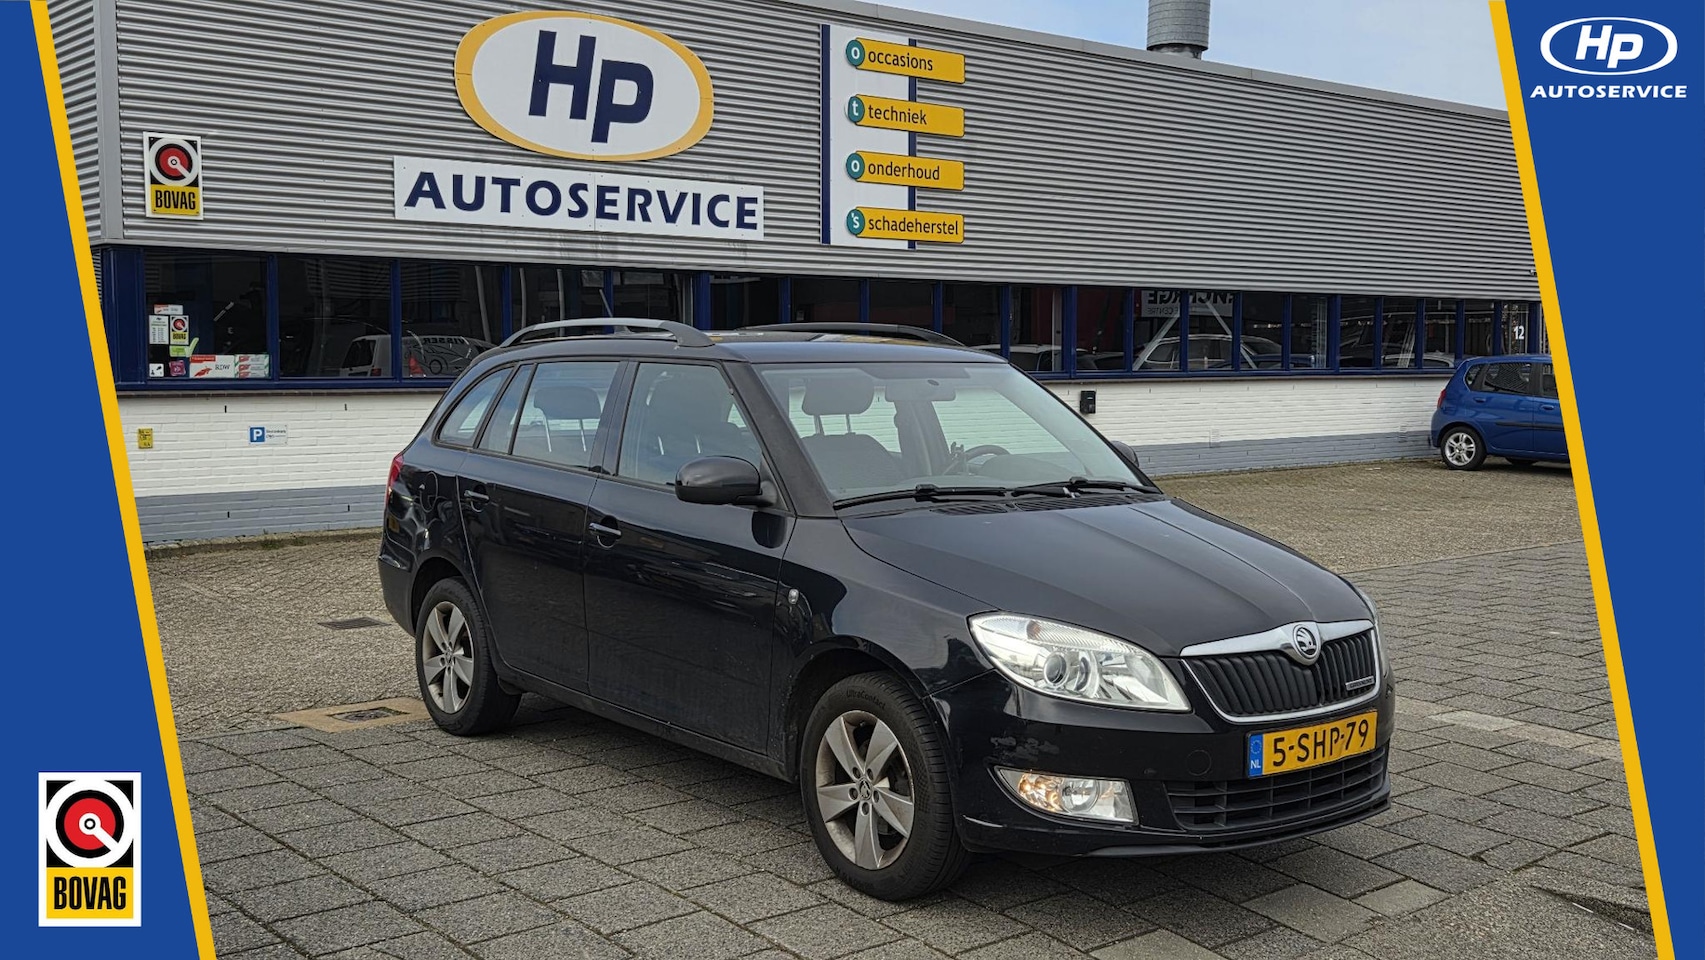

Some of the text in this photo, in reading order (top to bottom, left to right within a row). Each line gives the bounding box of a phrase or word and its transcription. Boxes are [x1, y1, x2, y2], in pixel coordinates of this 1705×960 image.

[868, 50, 933, 71] occasions
[868, 104, 927, 125] techniek
[868, 161, 940, 180] onderhoud
[155, 190, 196, 210] BOVAG
[405, 171, 758, 230] AUTOSERVICE
[868, 215, 959, 235] schadeherstel
[1513, 325, 1525, 340] 12
[253, 429, 263, 441] P
[1272, 719, 1369, 768] 5-SHP-79
[1250, 759, 1261, 769] NL
